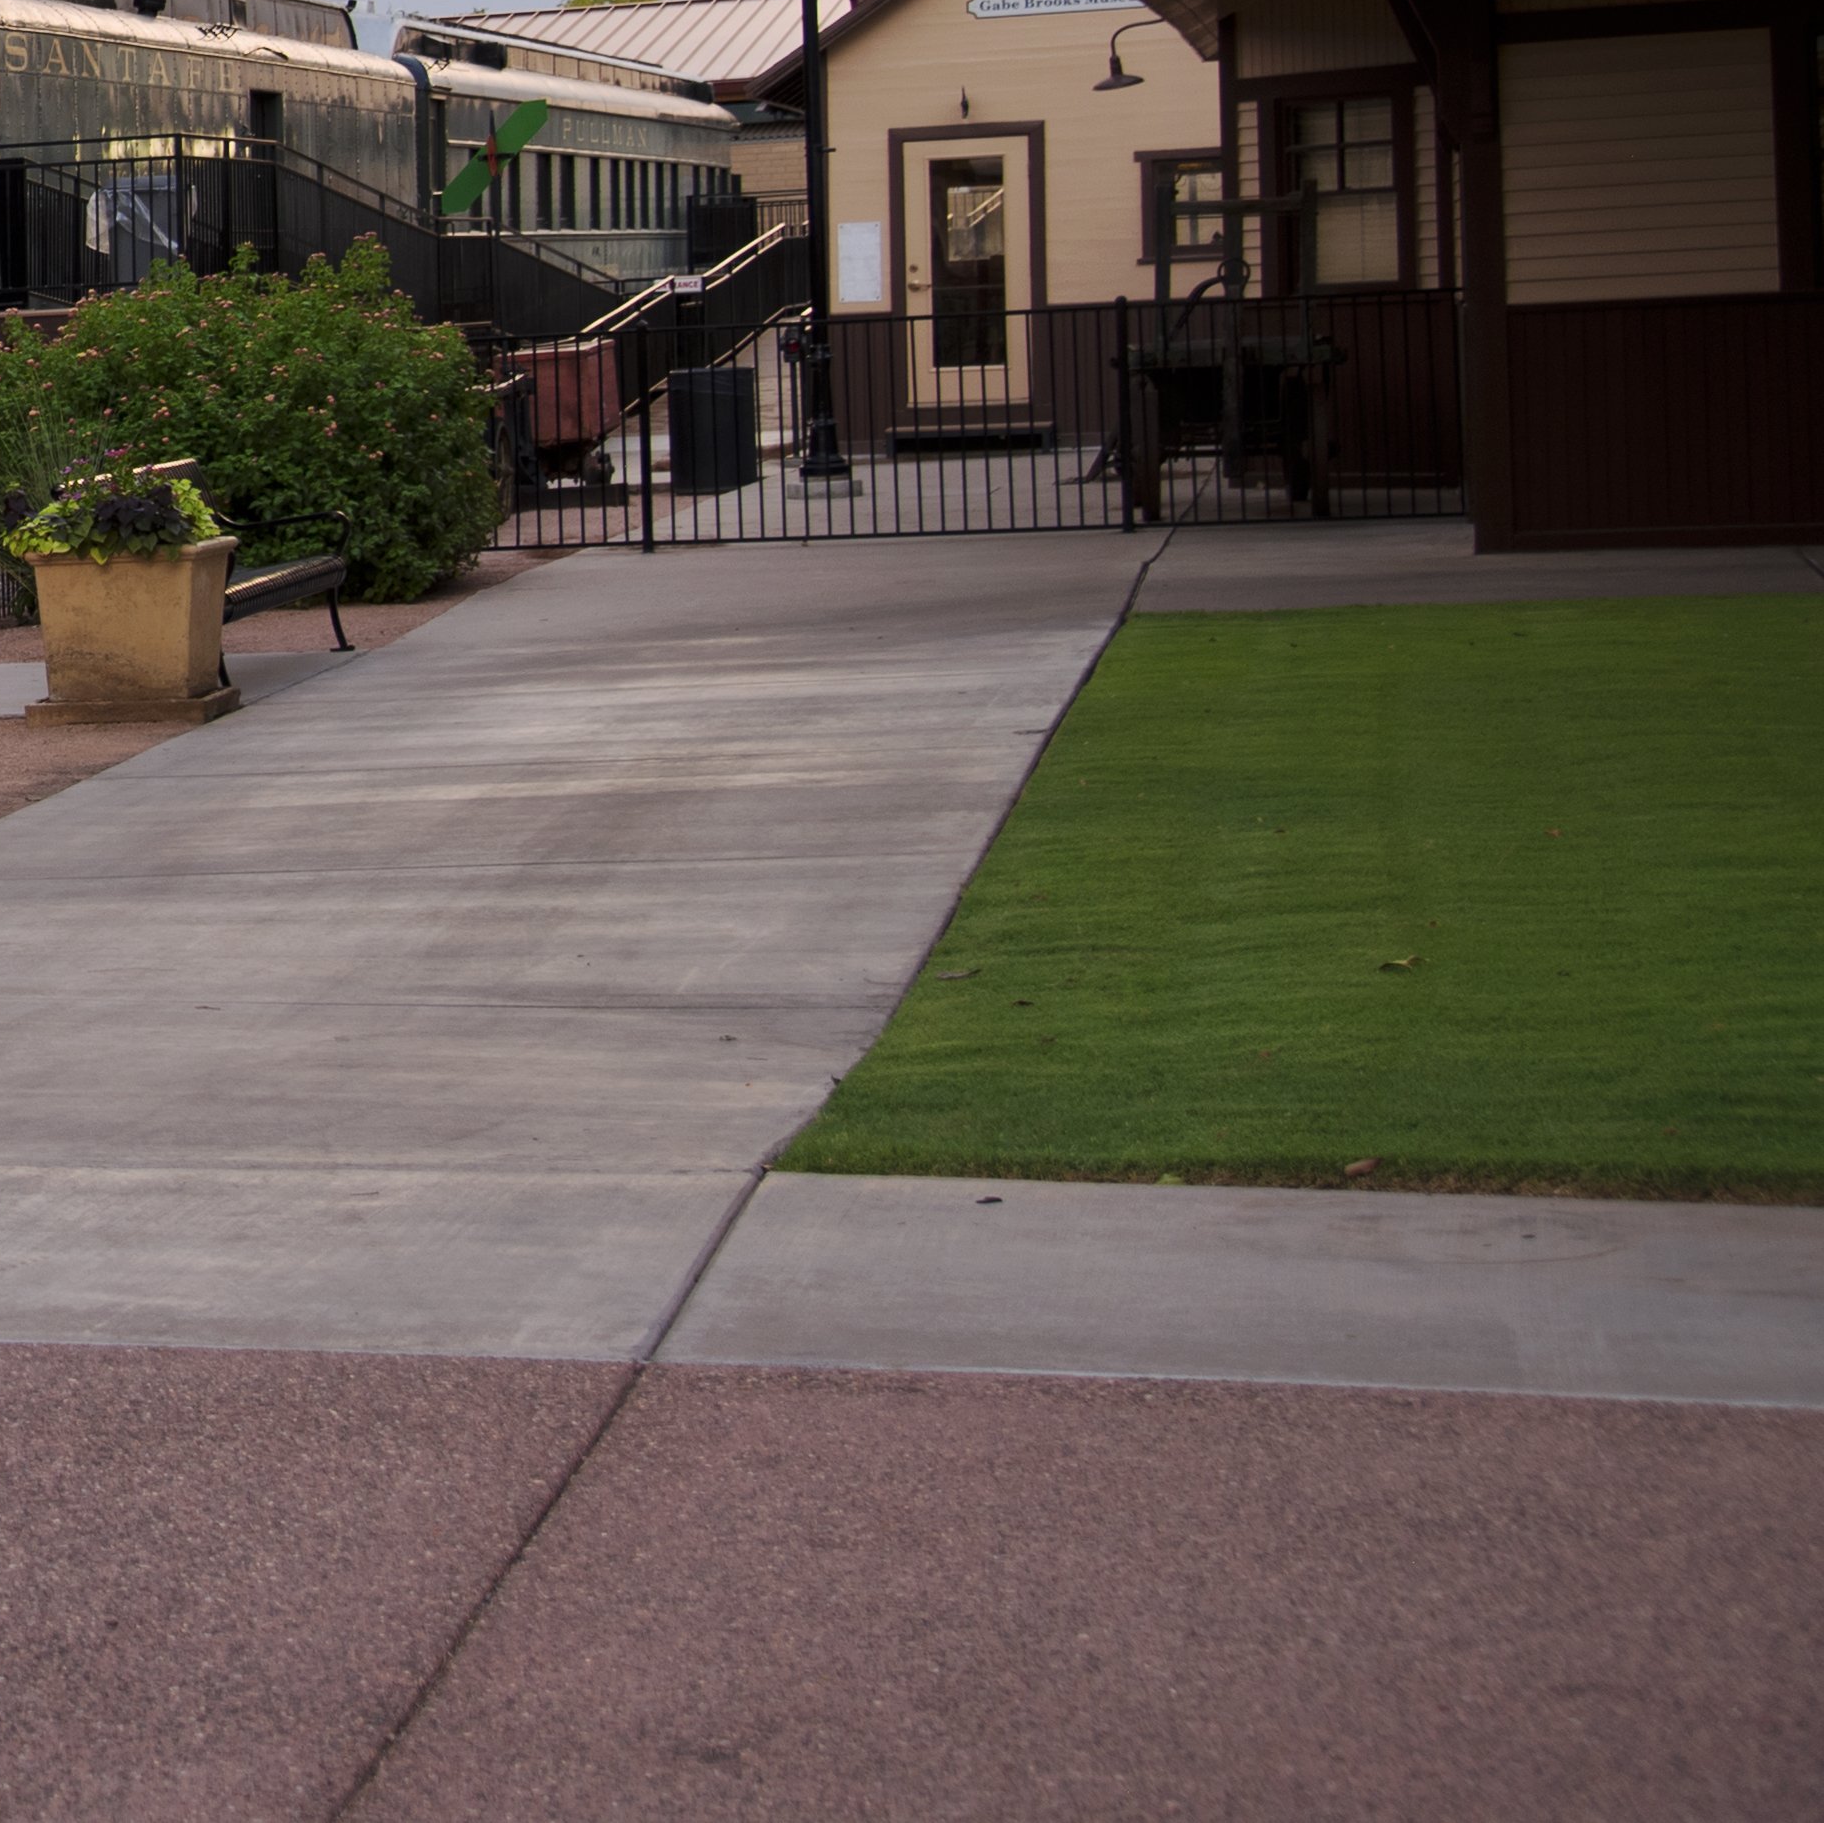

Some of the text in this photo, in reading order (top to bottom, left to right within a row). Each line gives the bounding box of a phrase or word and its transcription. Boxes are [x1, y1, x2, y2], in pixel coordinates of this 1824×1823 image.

[979, 0, 1020, 12] Gabe
[4, 31, 172, 87] SANTA
[562, 118, 648, 148] PULLMAN
